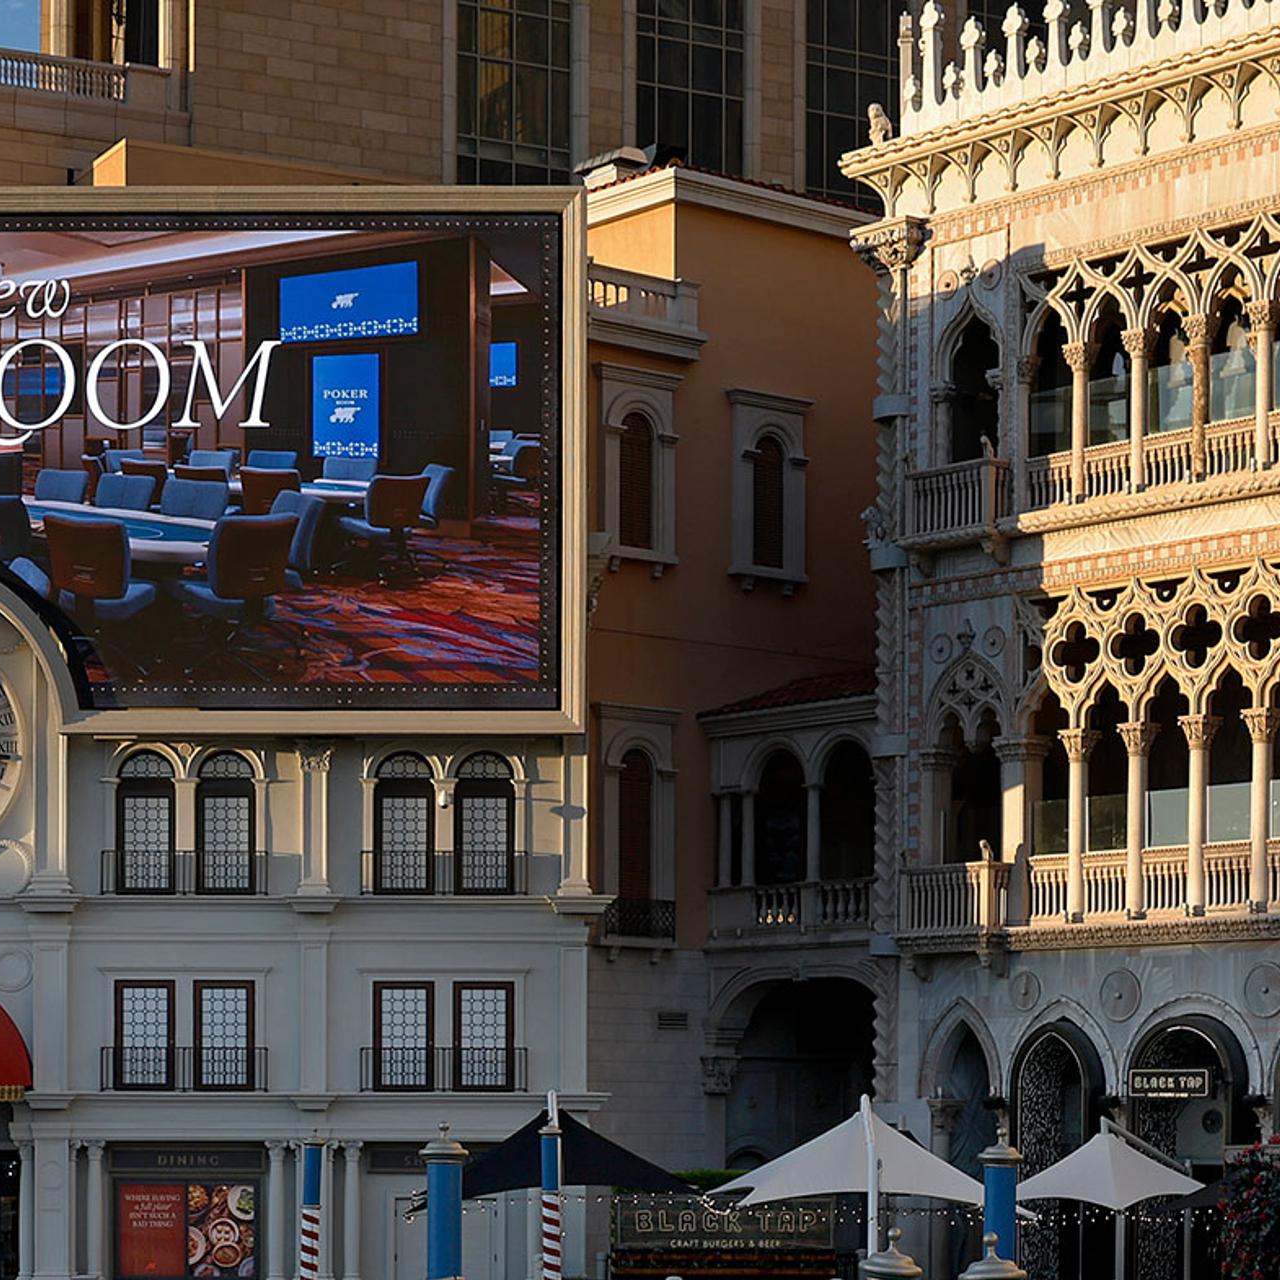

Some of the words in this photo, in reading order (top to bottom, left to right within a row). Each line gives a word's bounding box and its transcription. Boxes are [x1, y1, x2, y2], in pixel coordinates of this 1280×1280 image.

[323, 388, 368, 399] POKER
[1134, 1076, 1175, 1089] BLACK
[1179, 1076, 1203, 1089] TAP
[158, 1155, 219, 1165] DINING
[635, 1209, 743, 1233] BLACK
[756, 1209, 817, 1233] TAP
[669, 1239, 699, 1249] CRAFT
[702, 1239, 745, 1249] BURGERS
[758, 1239, 781, 1249] BEER
